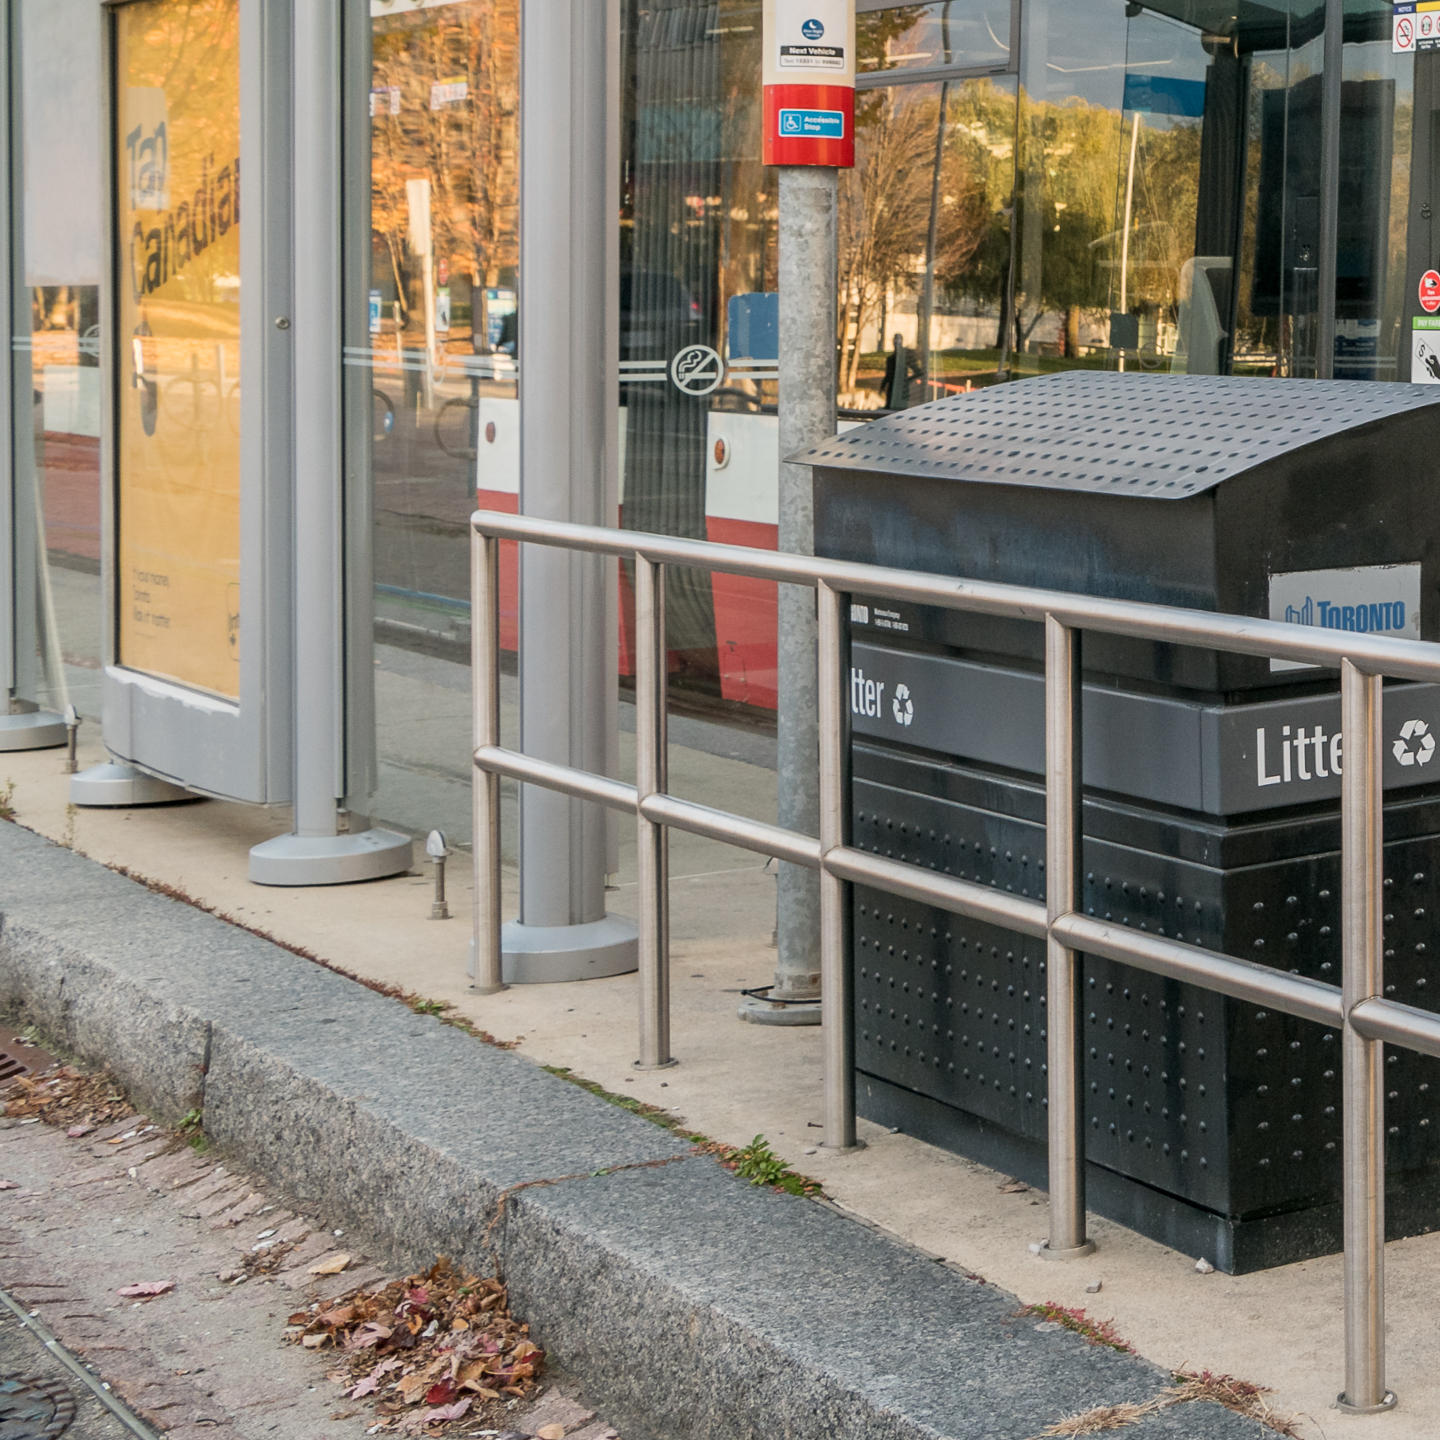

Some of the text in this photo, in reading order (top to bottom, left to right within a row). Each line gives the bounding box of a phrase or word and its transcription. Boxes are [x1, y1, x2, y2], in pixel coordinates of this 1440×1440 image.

[789, 47, 836, 56] Next Vehicle
[804, 116, 840, 124] Accessible
[126, 121, 168, 213] Tap
[1417, 319, 1427, 327] PAY
[1317, 600, 1405, 634] TORONTO
[851, 667, 884, 718] tter
[1257, 725, 1342, 787] Litte
